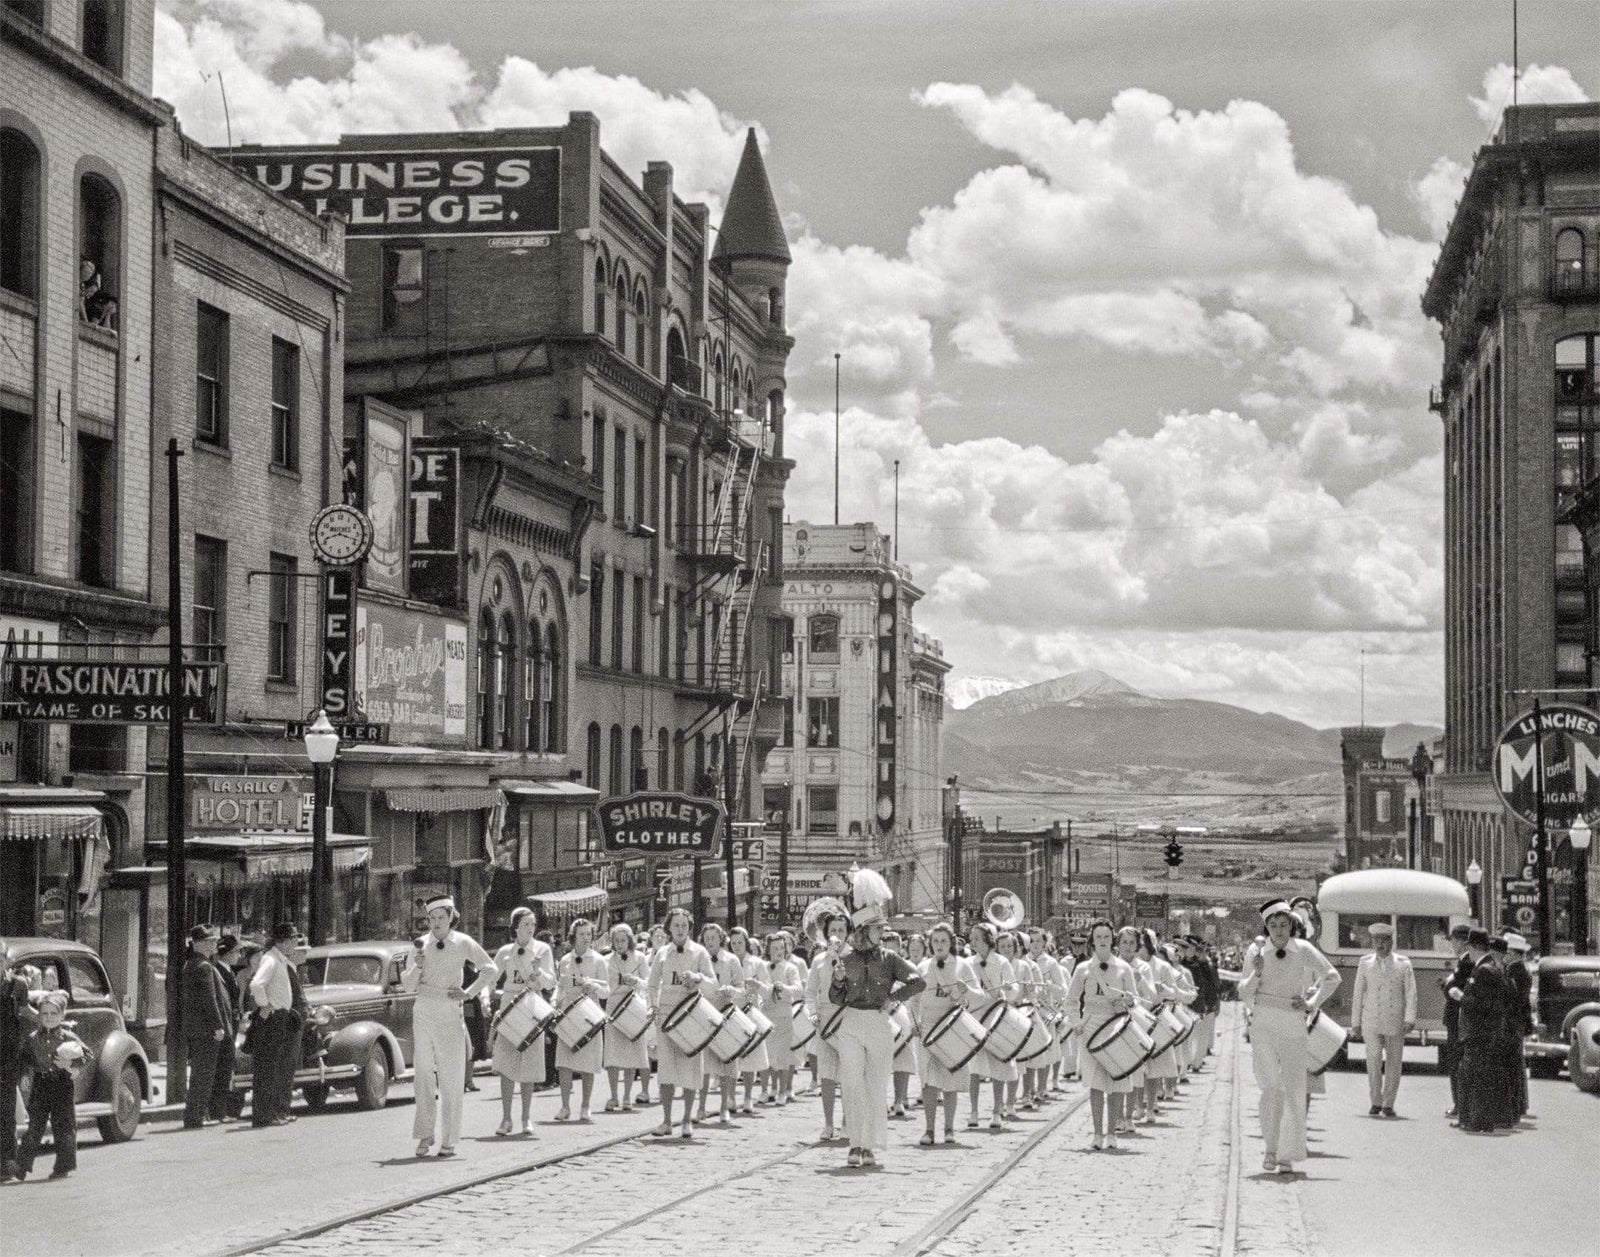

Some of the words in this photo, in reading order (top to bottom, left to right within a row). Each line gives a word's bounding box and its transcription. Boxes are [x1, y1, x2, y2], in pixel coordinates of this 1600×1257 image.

[19, 664, 204, 698] FASCINATIN
[91, 703, 122, 718] OF
[134, 704, 202, 720] SKIL
[289, 725, 378, 739] JELER
[212, 779, 230, 793] LA
[236, 779, 279, 793] SALLE
[1543, 792, 1585, 804] IGARS
[199, 798, 290, 826] HOTEL
[609, 801, 711, 827] SHIRLEY
[1524, 808, 1561, 829] FISING
[615, 831, 702, 845] CLOTHES
[794, 879, 822, 888] BRIDE
